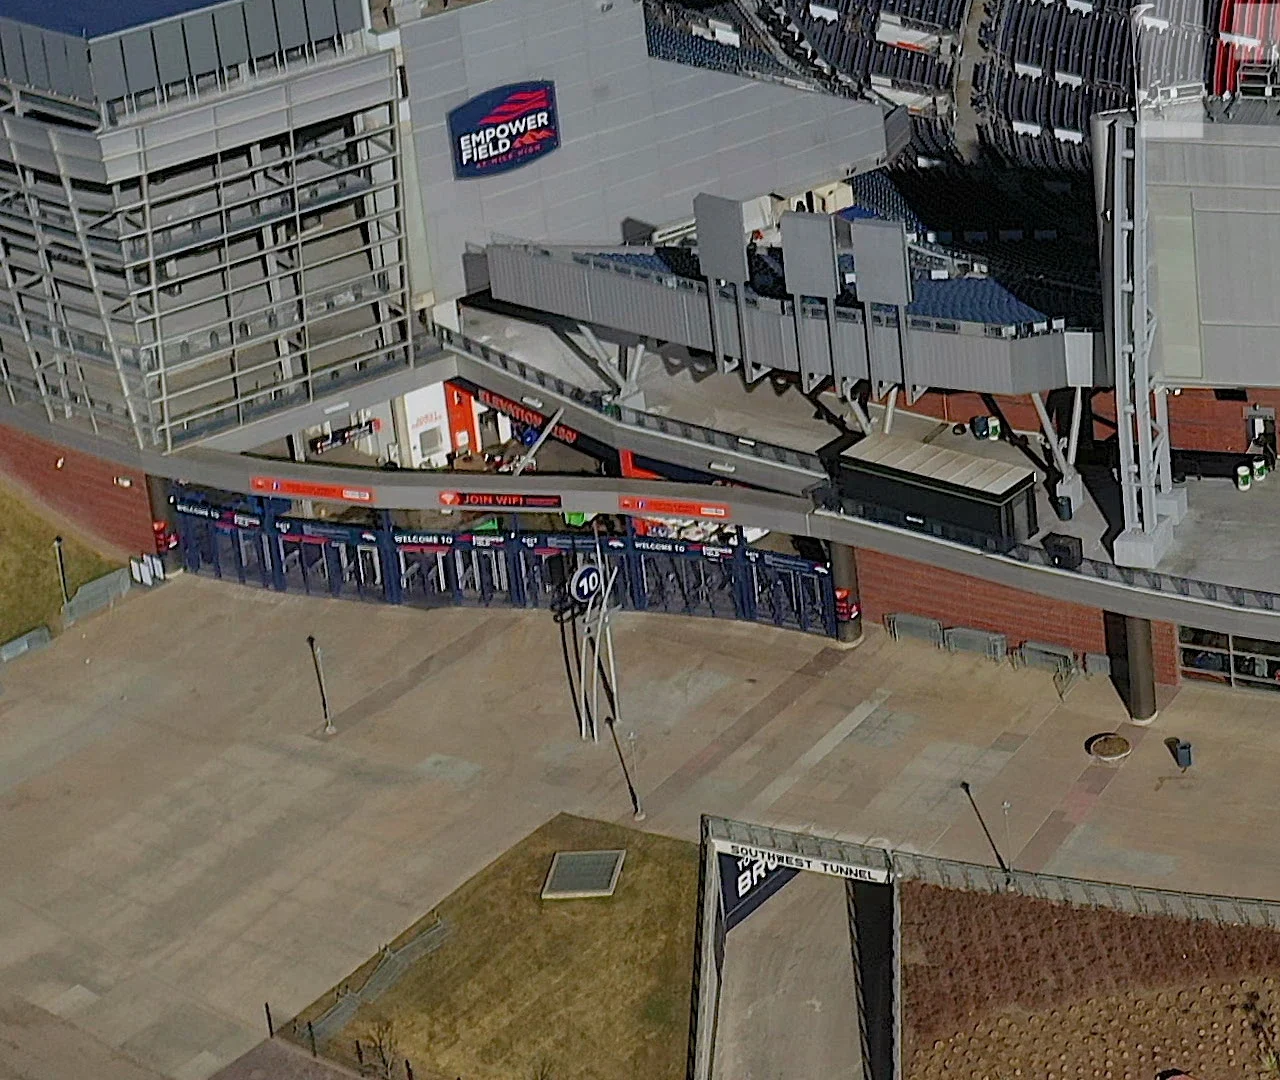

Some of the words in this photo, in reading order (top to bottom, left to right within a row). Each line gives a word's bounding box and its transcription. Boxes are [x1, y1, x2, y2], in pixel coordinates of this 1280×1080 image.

[460, 111, 549, 151] EMPOWER
[462, 138, 511, 165] FIELD
[464, 494, 493, 506] JOIN
[496, 495, 524, 506] WIFI
[394, 534, 439, 545] WELCOME
[440, 535, 453, 545] TO
[634, 541, 674, 552] WELCOME
[675, 544, 686, 553] TO
[578, 572, 599, 595] 10
[730, 845, 812, 870] SOUTHWEST
[820, 862, 878, 881] TUNNEL
